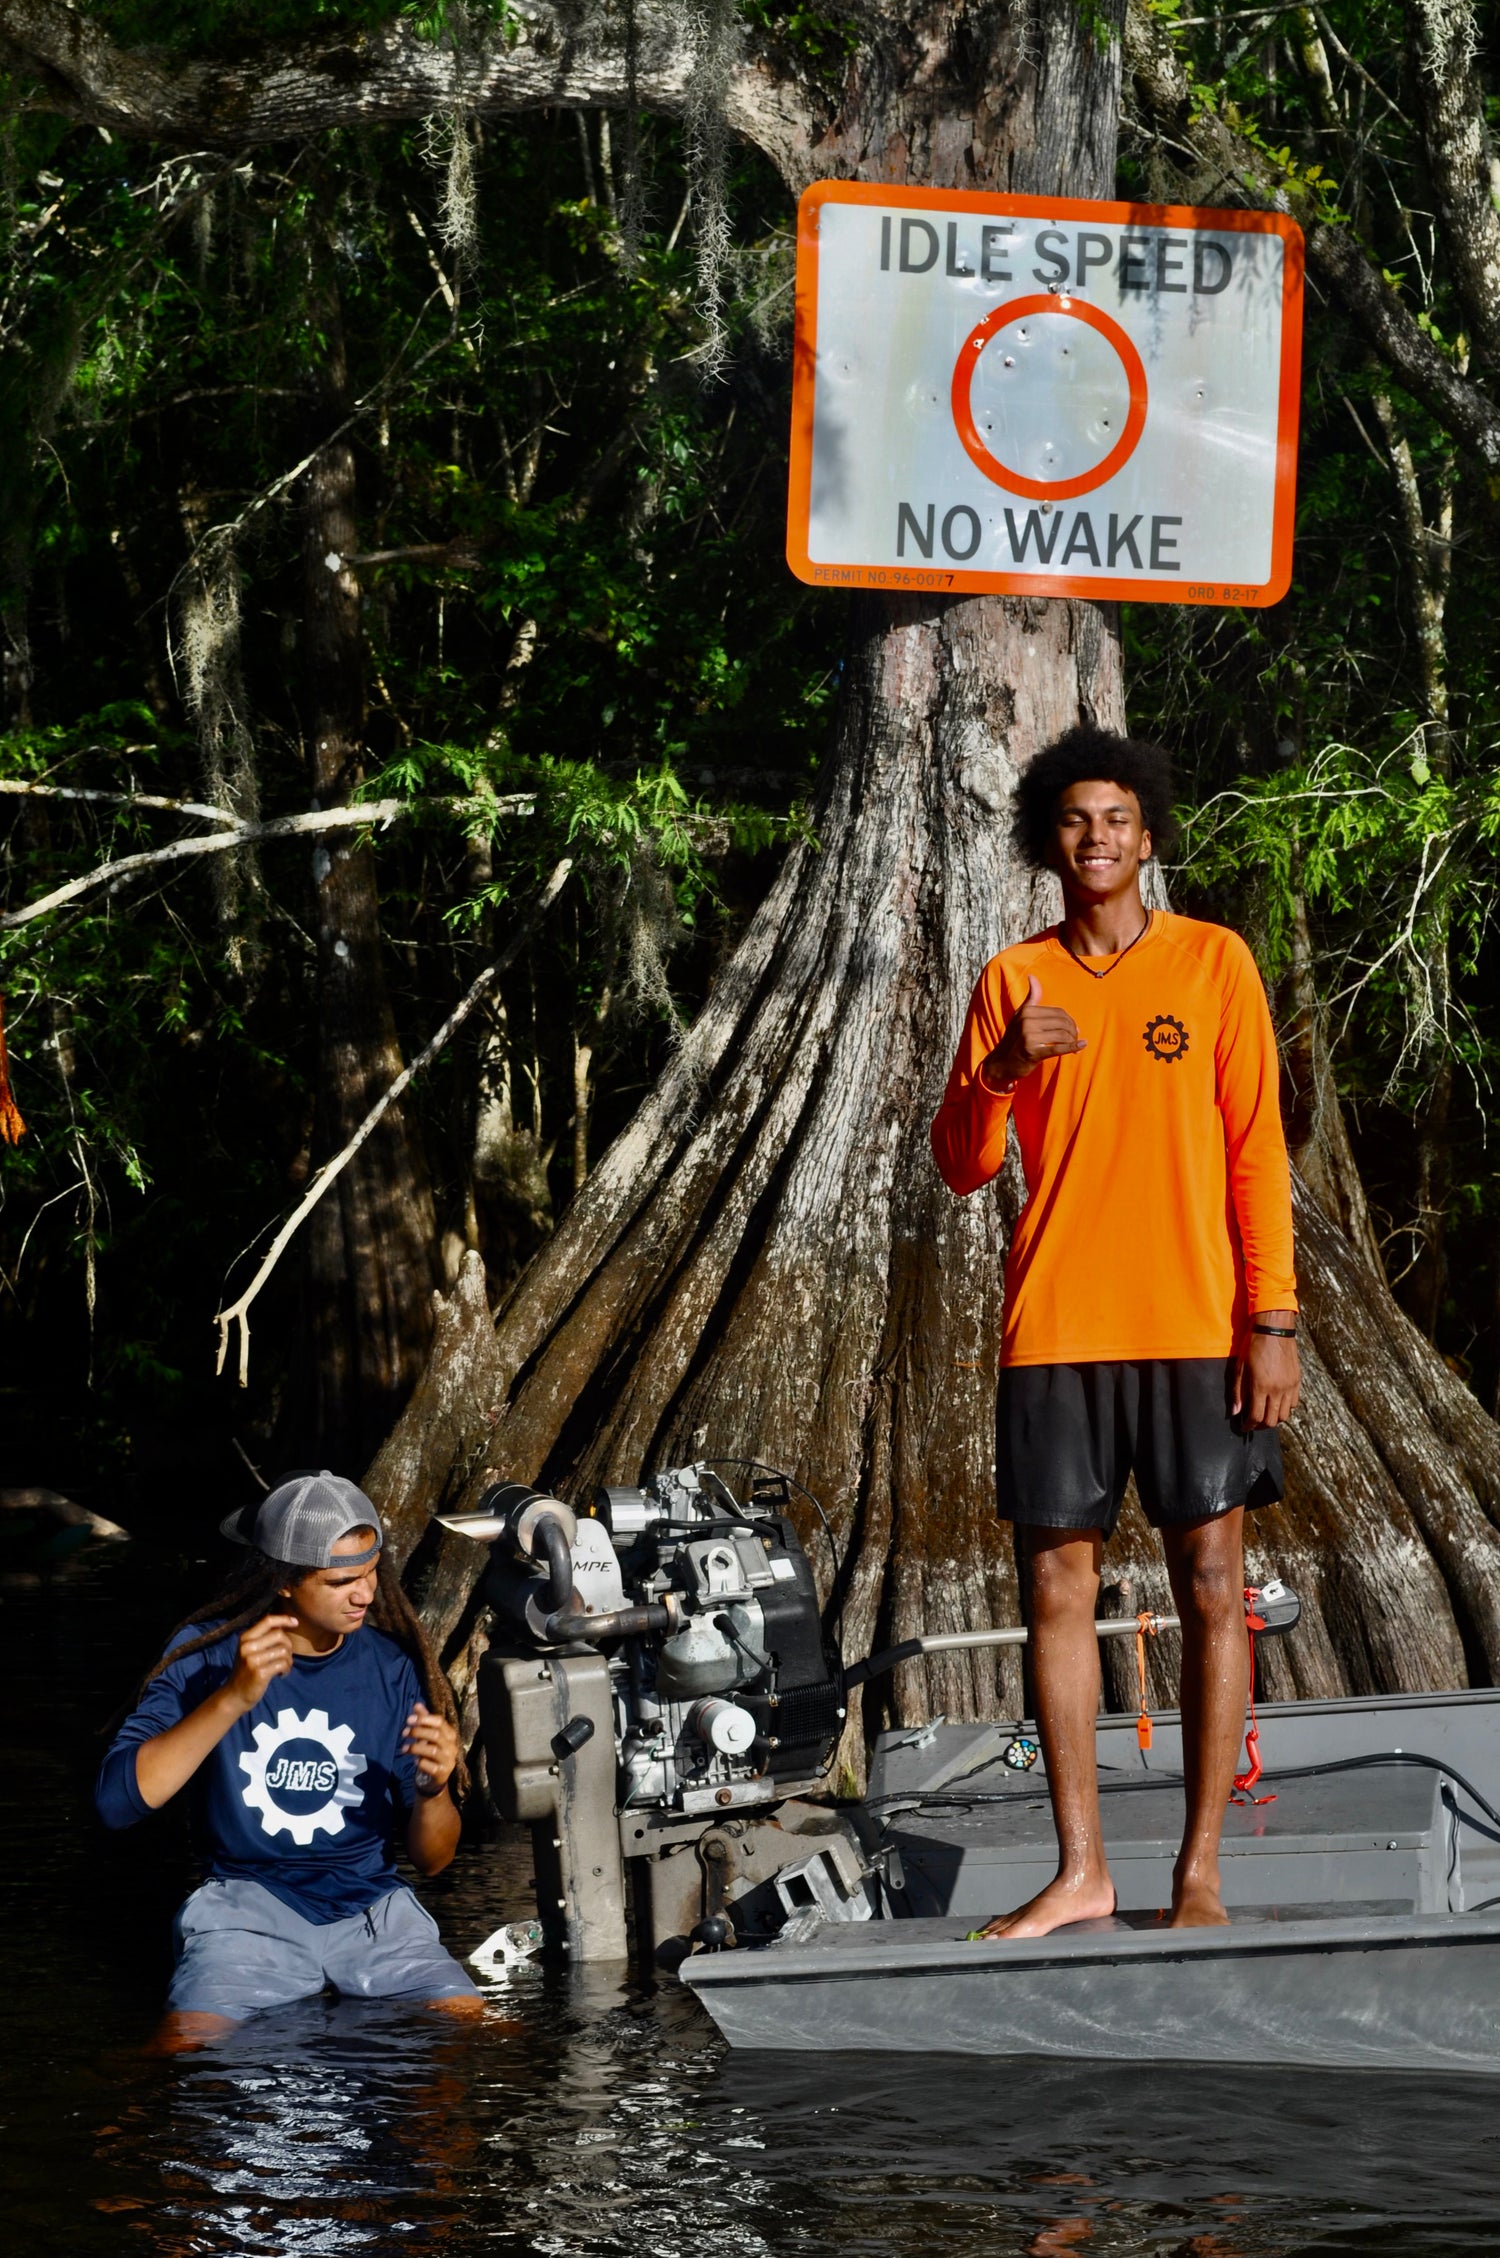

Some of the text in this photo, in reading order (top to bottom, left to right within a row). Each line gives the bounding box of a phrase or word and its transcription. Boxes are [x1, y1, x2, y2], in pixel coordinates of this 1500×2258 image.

[880, 216, 1233, 295] IDLE SPEED
[896, 502, 1183, 571] NO WAKE
[814, 568, 863, 582] PERMIT
[1223, 588, 1259, 601] 82-17
[1154, 1032, 1179, 1045] JMS
[266, 1758, 337, 1791] JMS
